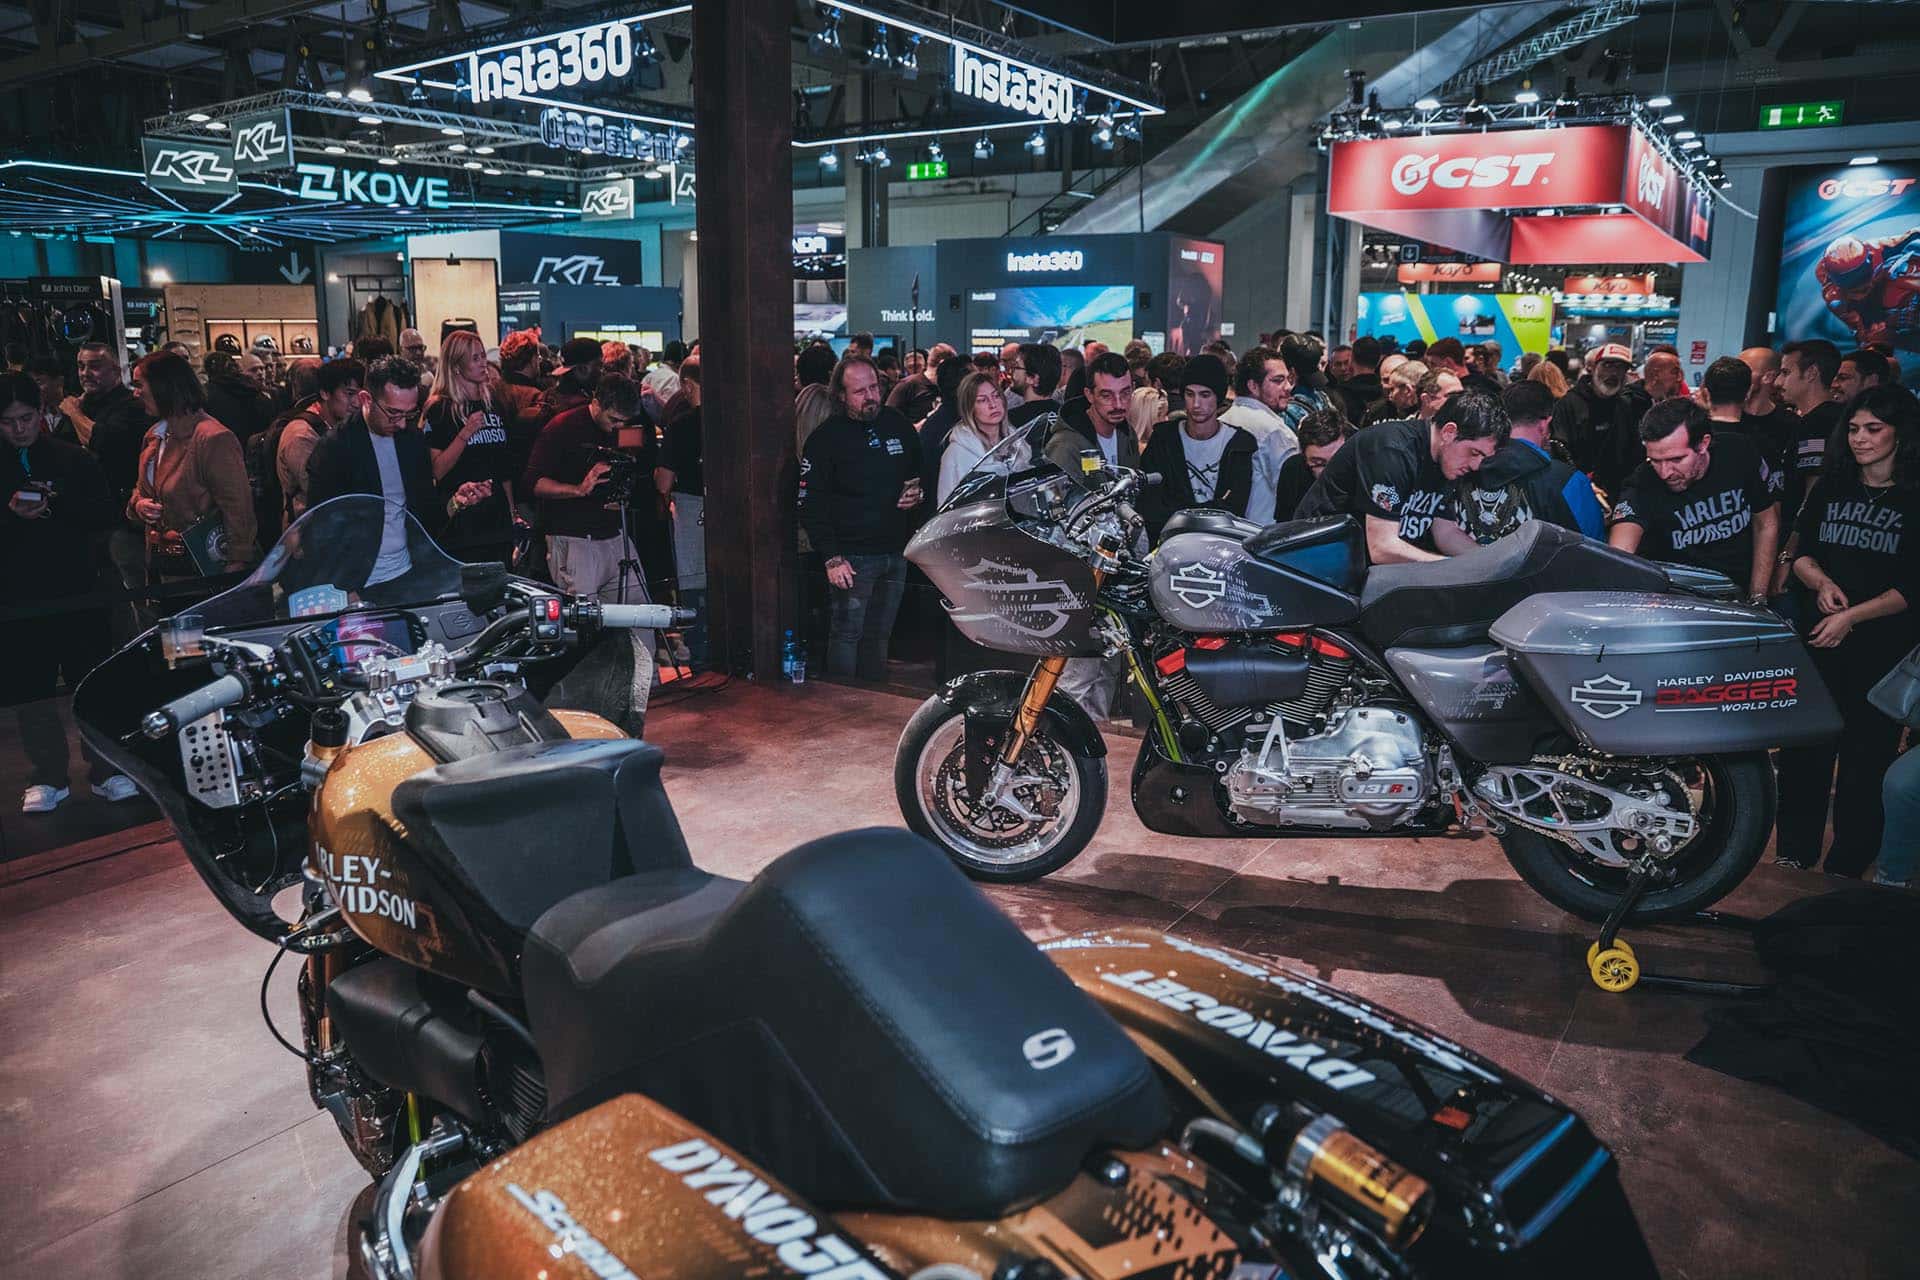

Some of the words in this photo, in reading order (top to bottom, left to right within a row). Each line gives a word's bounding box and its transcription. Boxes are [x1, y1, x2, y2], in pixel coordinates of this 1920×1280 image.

[470, 23, 632, 103] Insta360
[954, 42, 1073, 124] Insta360
[234, 121, 286, 162] KL
[150, 150, 234, 184] KL
[1432, 152, 1555, 188] CST
[342, 168, 449, 209] KOVE
[582, 186, 629, 215] KL
[1007, 250, 1083, 272] Insta360
[880, 310, 907, 322] Think
[1827, 501, 1903, 530] HARLEY-
[1818, 520, 1901, 554] DAVIDSON
[1655, 677, 1798, 705] BAGGER
[1656, 674, 1715, 687] HARLEY
[1724, 667, 1795, 683] DAVIDSON
[1721, 701, 1767, 713] WORLD
[1770, 698, 1798, 709] CUP
[1100, 969, 1376, 1091] DYNOJET
